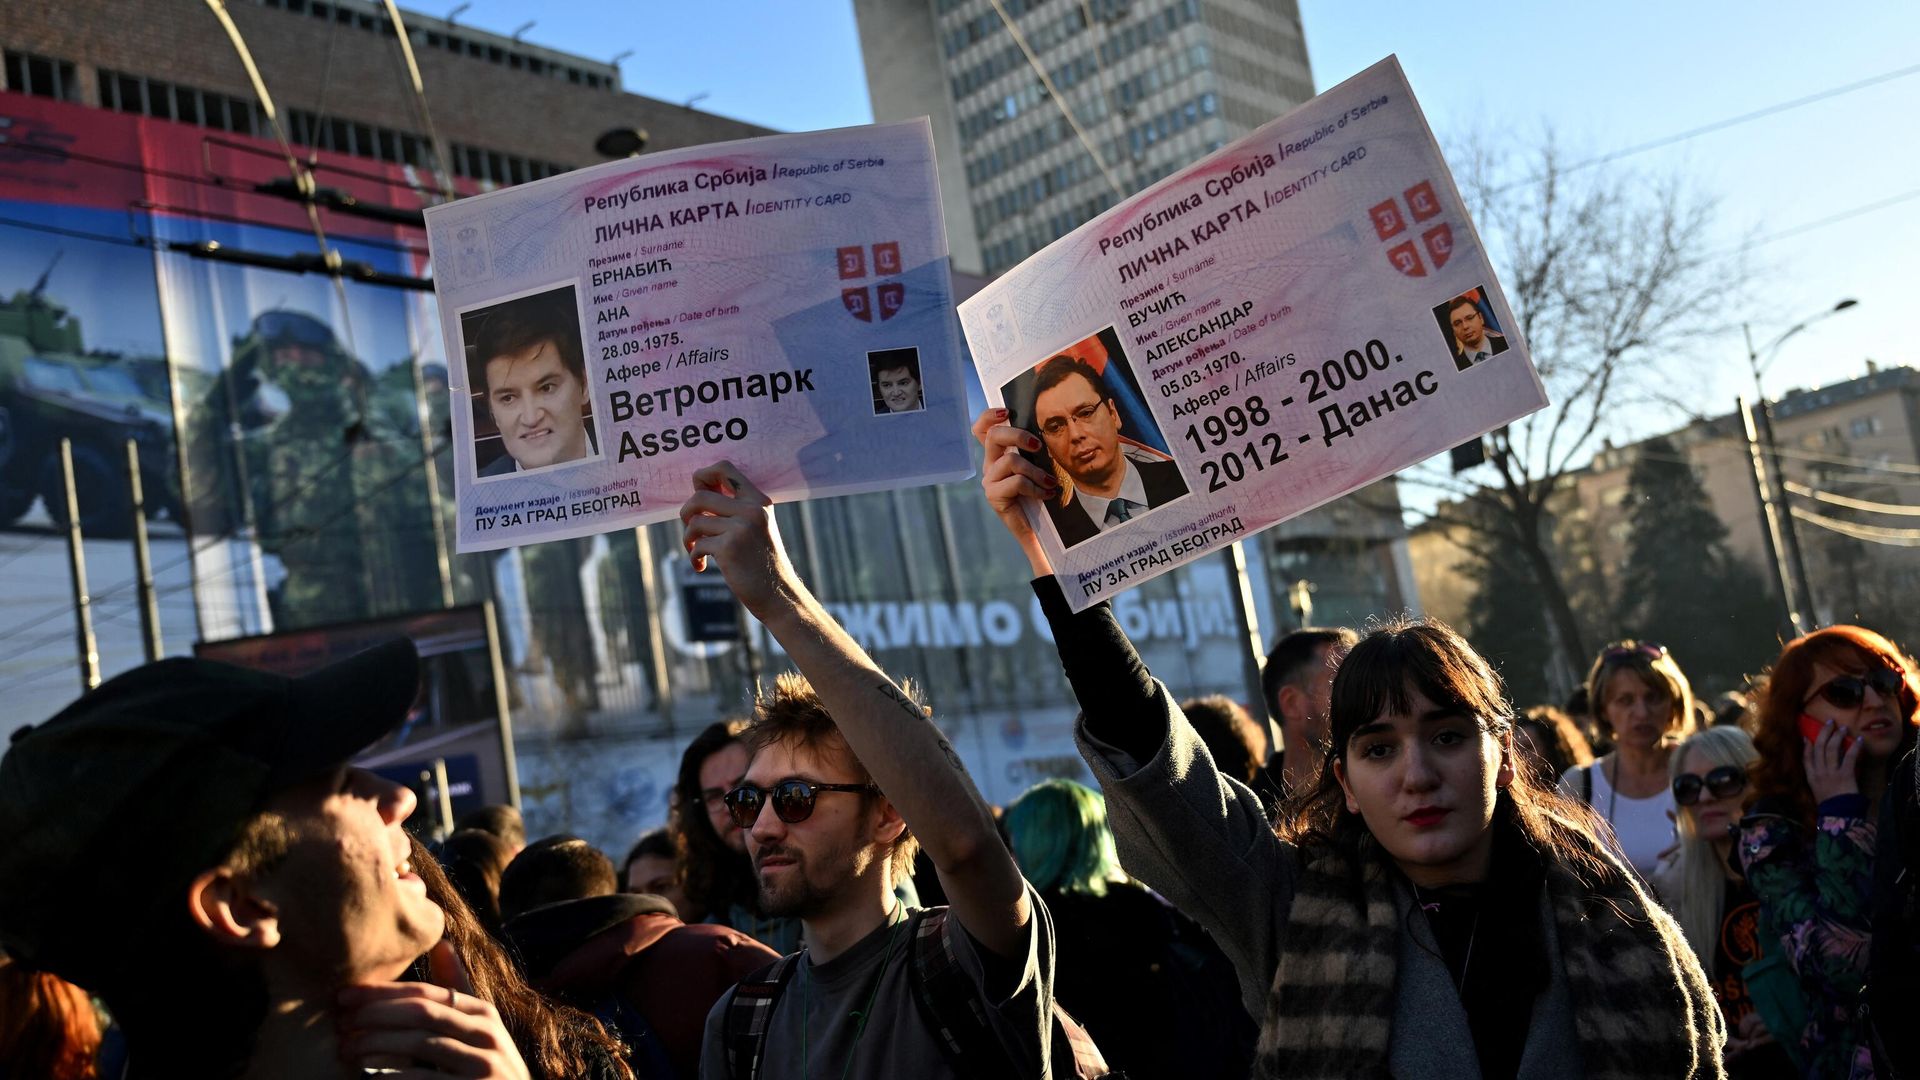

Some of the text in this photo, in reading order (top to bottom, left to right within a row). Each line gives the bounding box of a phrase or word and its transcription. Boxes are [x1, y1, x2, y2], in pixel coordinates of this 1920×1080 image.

[584, 179, 688, 213] Република
[695, 168, 767, 192] Србија
[832, 160, 844, 171] of
[847, 157, 884, 169] Serbia
[1099, 194, 1203, 256] Република
[1205, 153, 1275, 199] Србија
[1338, 115, 1349, 130] of
[1352, 95, 1388, 121] Serbia
[595, 213, 664, 244] ЛИЧНА
[670, 201, 739, 227] КАРТА
[815, 192, 851, 206] CARD
[1118, 236, 1189, 283] ЛИЧНА
[1191, 200, 1261, 245] КАРТА
[1330, 146, 1367, 173] CARD
[589, 251, 631, 268] Презиме
[641, 240, 683, 256] Surname
[592, 259, 672, 286] БРНАБИЋ
[593, 293, 613, 305] Име
[622, 285, 648, 298] Given
[651, 279, 678, 291] name
[1120, 283, 1164, 310] Презиме
[1172, 256, 1214, 283] Surname
[597, 306, 629, 324] АНА
[598, 326, 627, 341] Датум
[630, 317, 670, 334] рођења
[680, 309, 702, 322] Date
[704, 307, 716, 318] of
[718, 305, 739, 315] birth
[1128, 292, 1186, 328] ВУЧИЋ
[1136, 329, 1158, 345] Име
[1165, 313, 1192, 330] Given
[1195, 298, 1221, 315] name
[1146, 301, 1253, 364] АЛЕКСАНДАР
[602, 332, 684, 360] 28.09.1975.
[605, 359, 661, 383] Афере
[676, 347, 729, 368] Affairs
[1152, 361, 1183, 381] Датум
[1186, 338, 1226, 365] рођења
[1234, 324, 1256, 340] Date
[1258, 316, 1269, 328] of
[1271, 305, 1292, 320] birth
[610, 368, 814, 422] Ветропарк
[1161, 351, 1245, 398] 05.03.1970.
[1172, 383, 1230, 420] Афере
[1245, 353, 1296, 387] Affairs
[1185, 339, 1403, 454] 1998 - 2000.
[618, 417, 748, 463] Asseco
[1200, 369, 1438, 493] 2012 - Данас
[475, 502, 525, 516] Документ
[528, 495, 560, 507] издаје
[603, 478, 638, 493] authority
[476, 491, 641, 531] ПУ ЗА ГРАД БЕОГРАД
[1078, 554, 1125, 584] Документ
[1127, 541, 1158, 561] издаје
[1199, 504, 1236, 526] authority
[1083, 517, 1244, 597] ПУ ЗА ГРАД БЕОГРАД
